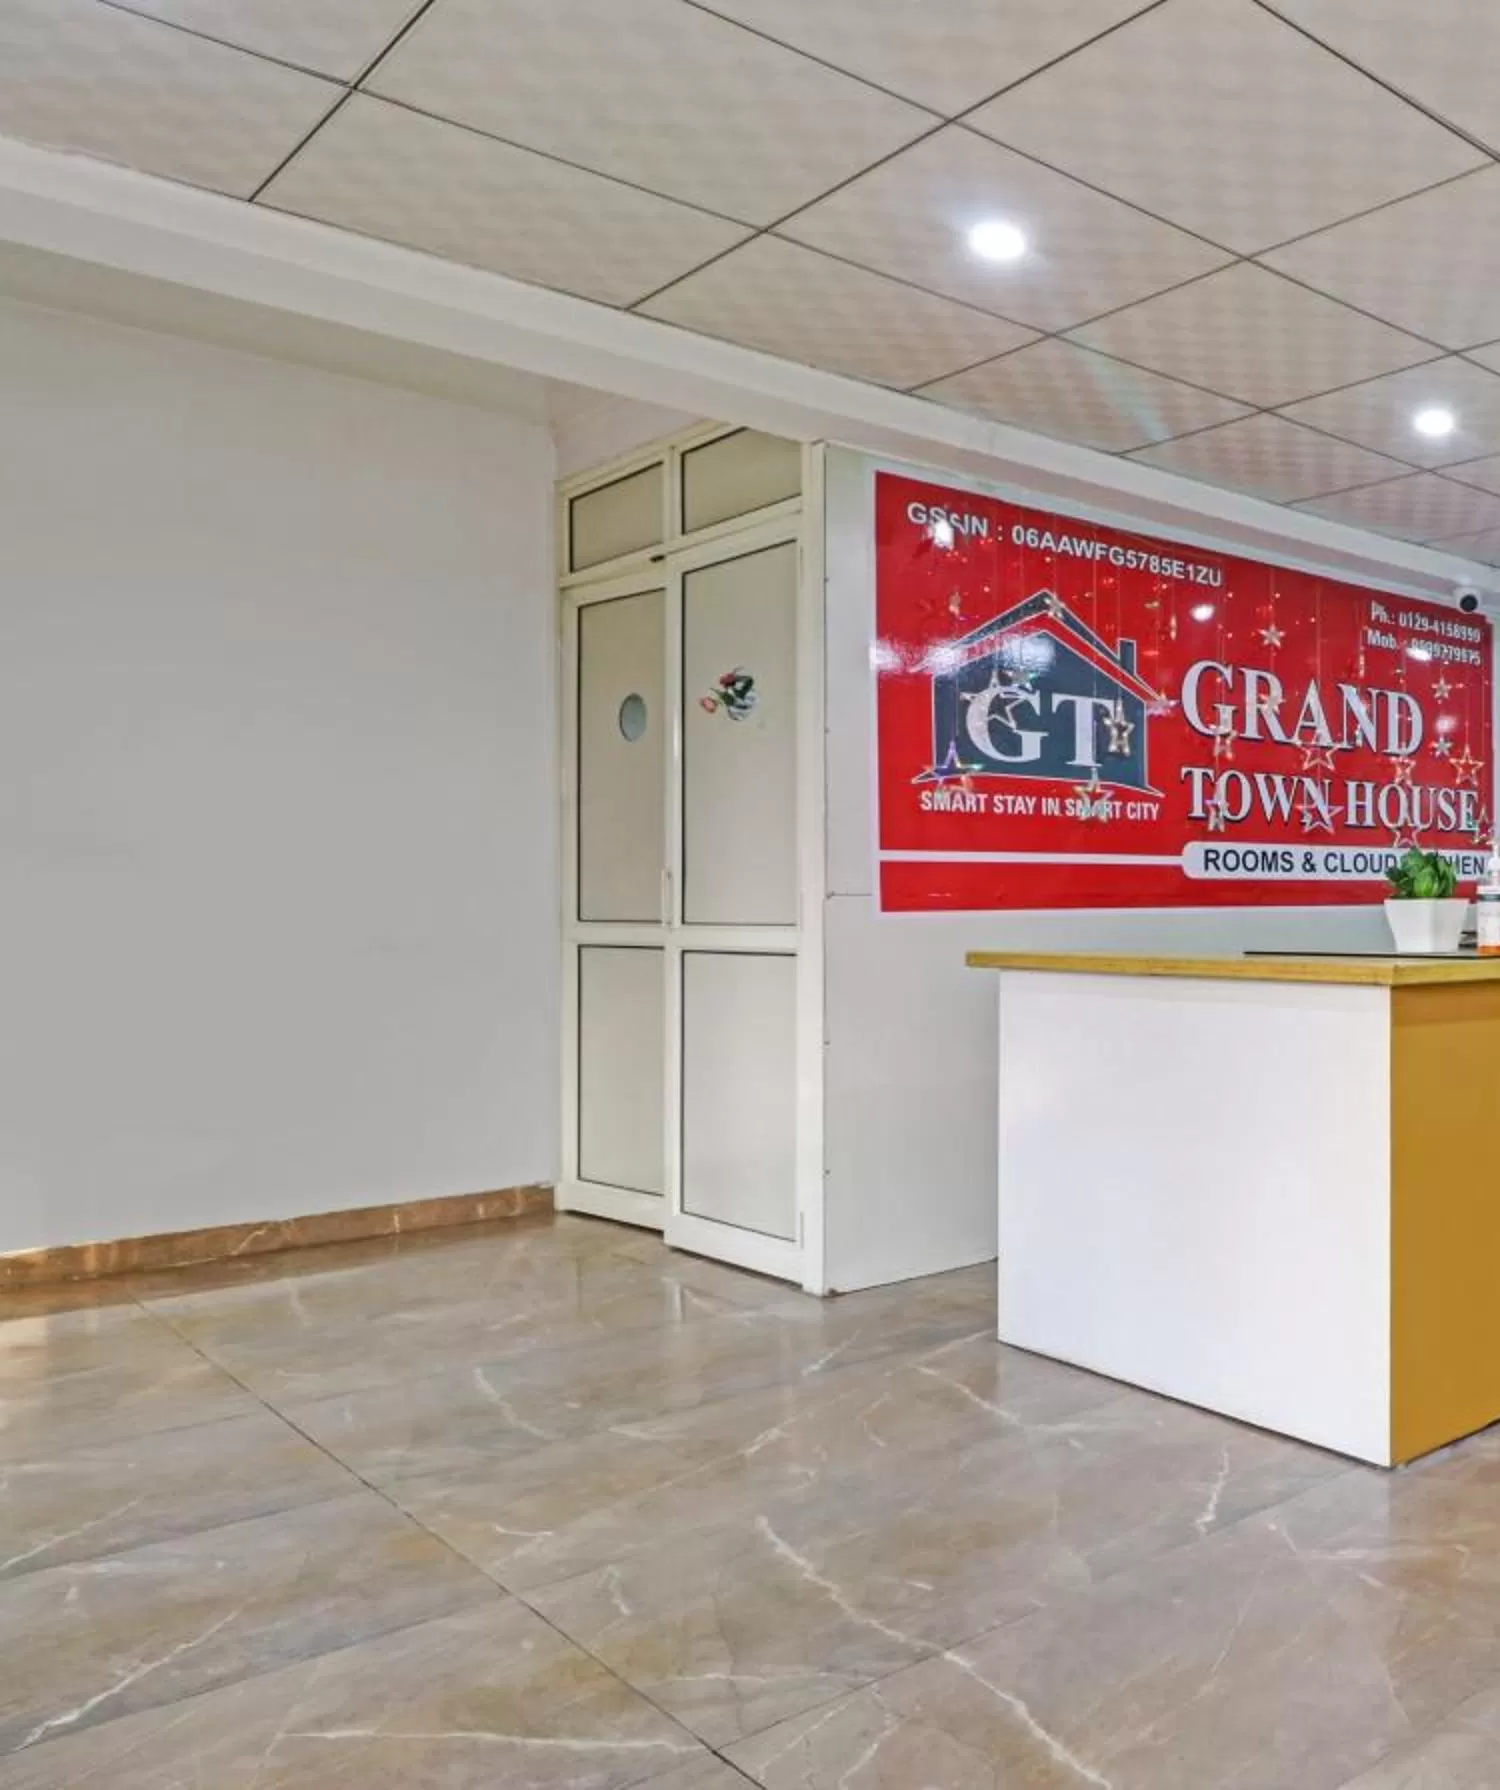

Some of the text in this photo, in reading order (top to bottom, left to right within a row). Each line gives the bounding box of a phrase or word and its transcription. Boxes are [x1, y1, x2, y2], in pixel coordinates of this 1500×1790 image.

[965, 685, 1115, 767] GT
[1181, 659, 1425, 757] GRAND
[920, 790, 1161, 821] SMART STAY IN SMART CITY
[1181, 766, 1480, 834] TOWN HOUSE
[1203, 849, 1295, 874] ROOMS
[1301, 850, 1317, 874] &
[1324, 852, 1398, 875] CLOUD
